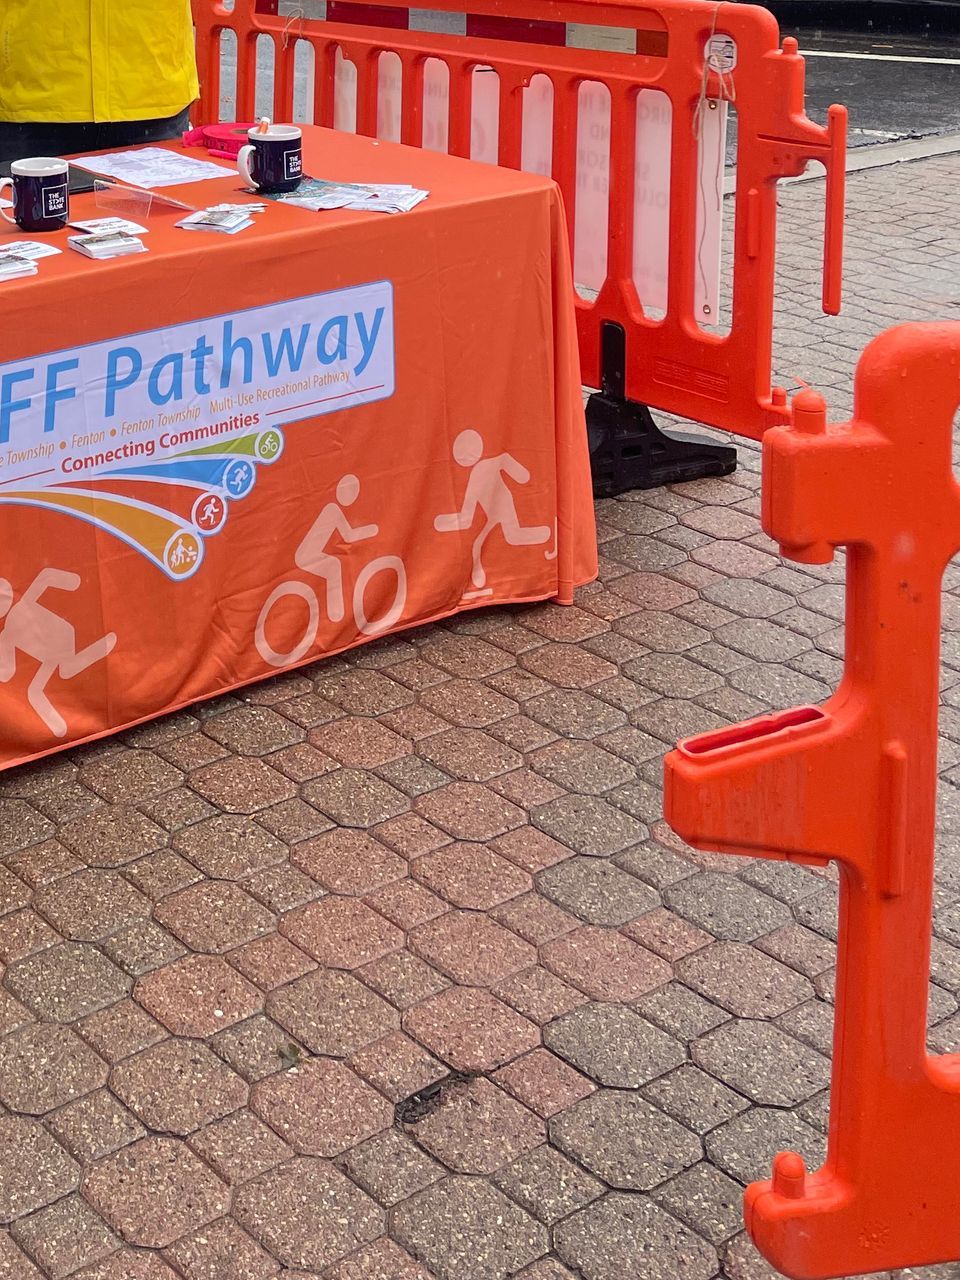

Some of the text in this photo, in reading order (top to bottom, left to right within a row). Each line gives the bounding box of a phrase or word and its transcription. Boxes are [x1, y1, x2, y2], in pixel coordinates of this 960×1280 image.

[49, 203, 64, 211] BANK
[105, 306, 385, 417] Pathway
[7, 441, 55, 466] Township
[71, 430, 105, 449] Fenton
[121, 417, 154, 436] Fenton
[158, 405, 201, 428] Township
[209, 393, 254, 415] Multi-Use
[256, 379, 311, 401] Recreational
[313, 369, 350, 387] Pathway
[61, 412, 260, 474] Connecting Communities
